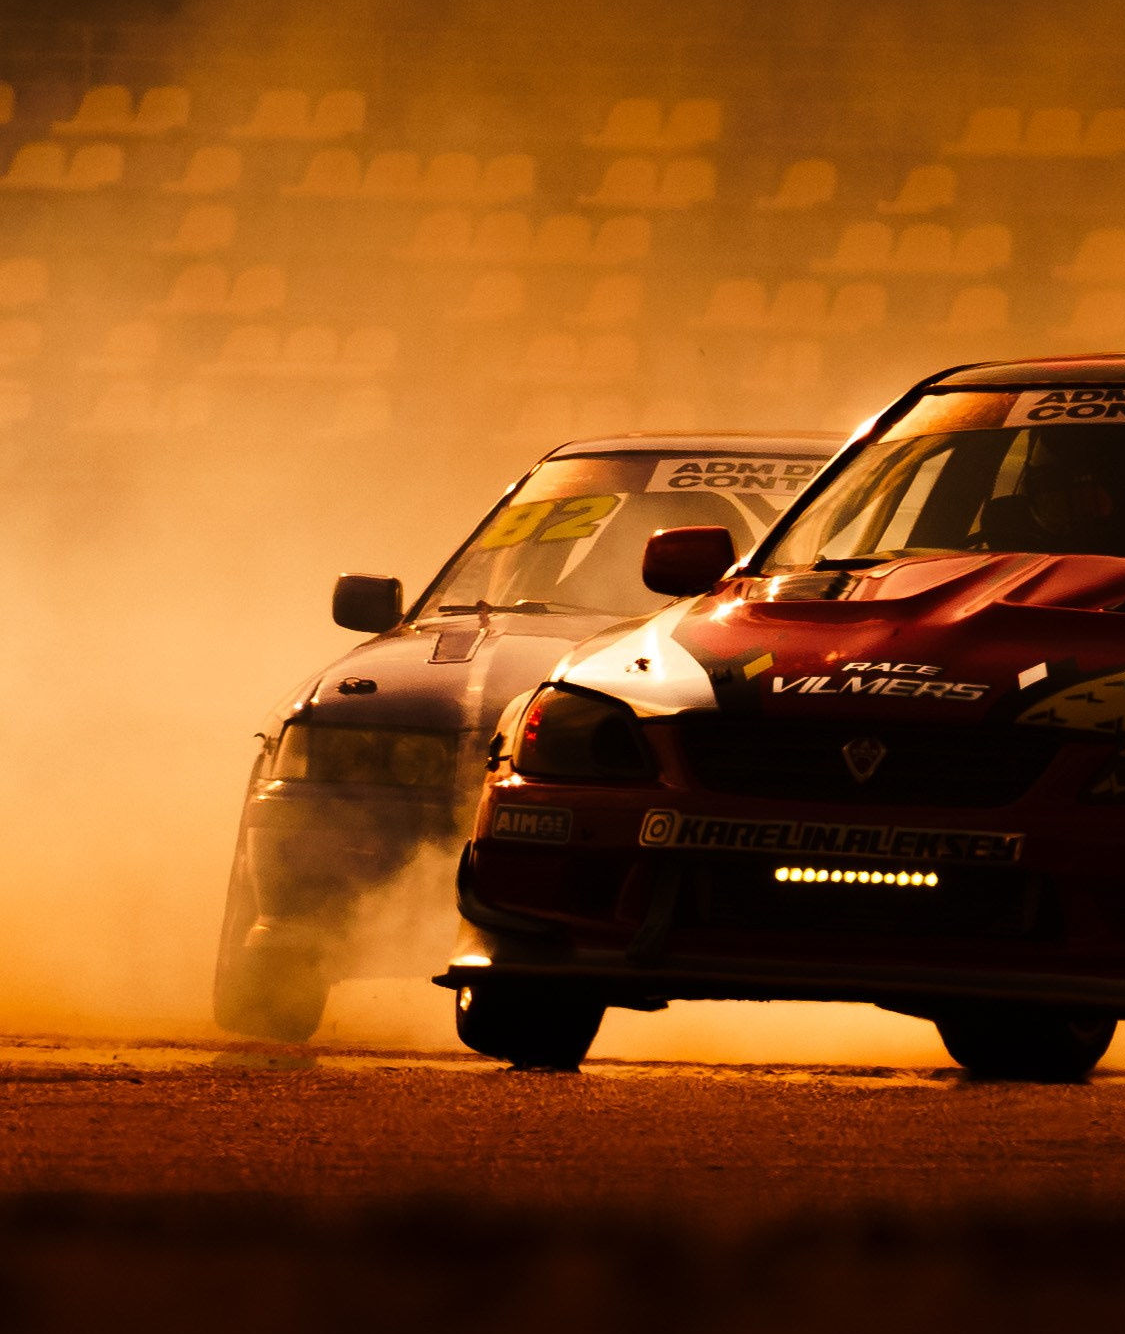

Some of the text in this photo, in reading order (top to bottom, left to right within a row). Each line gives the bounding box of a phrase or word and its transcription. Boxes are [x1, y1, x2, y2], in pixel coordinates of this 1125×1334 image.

[673, 462, 776, 475] ADM
[481, 495, 617, 549] 82
[841, 662, 943, 676] RACE
[772, 676, 991, 701] VILMERS
